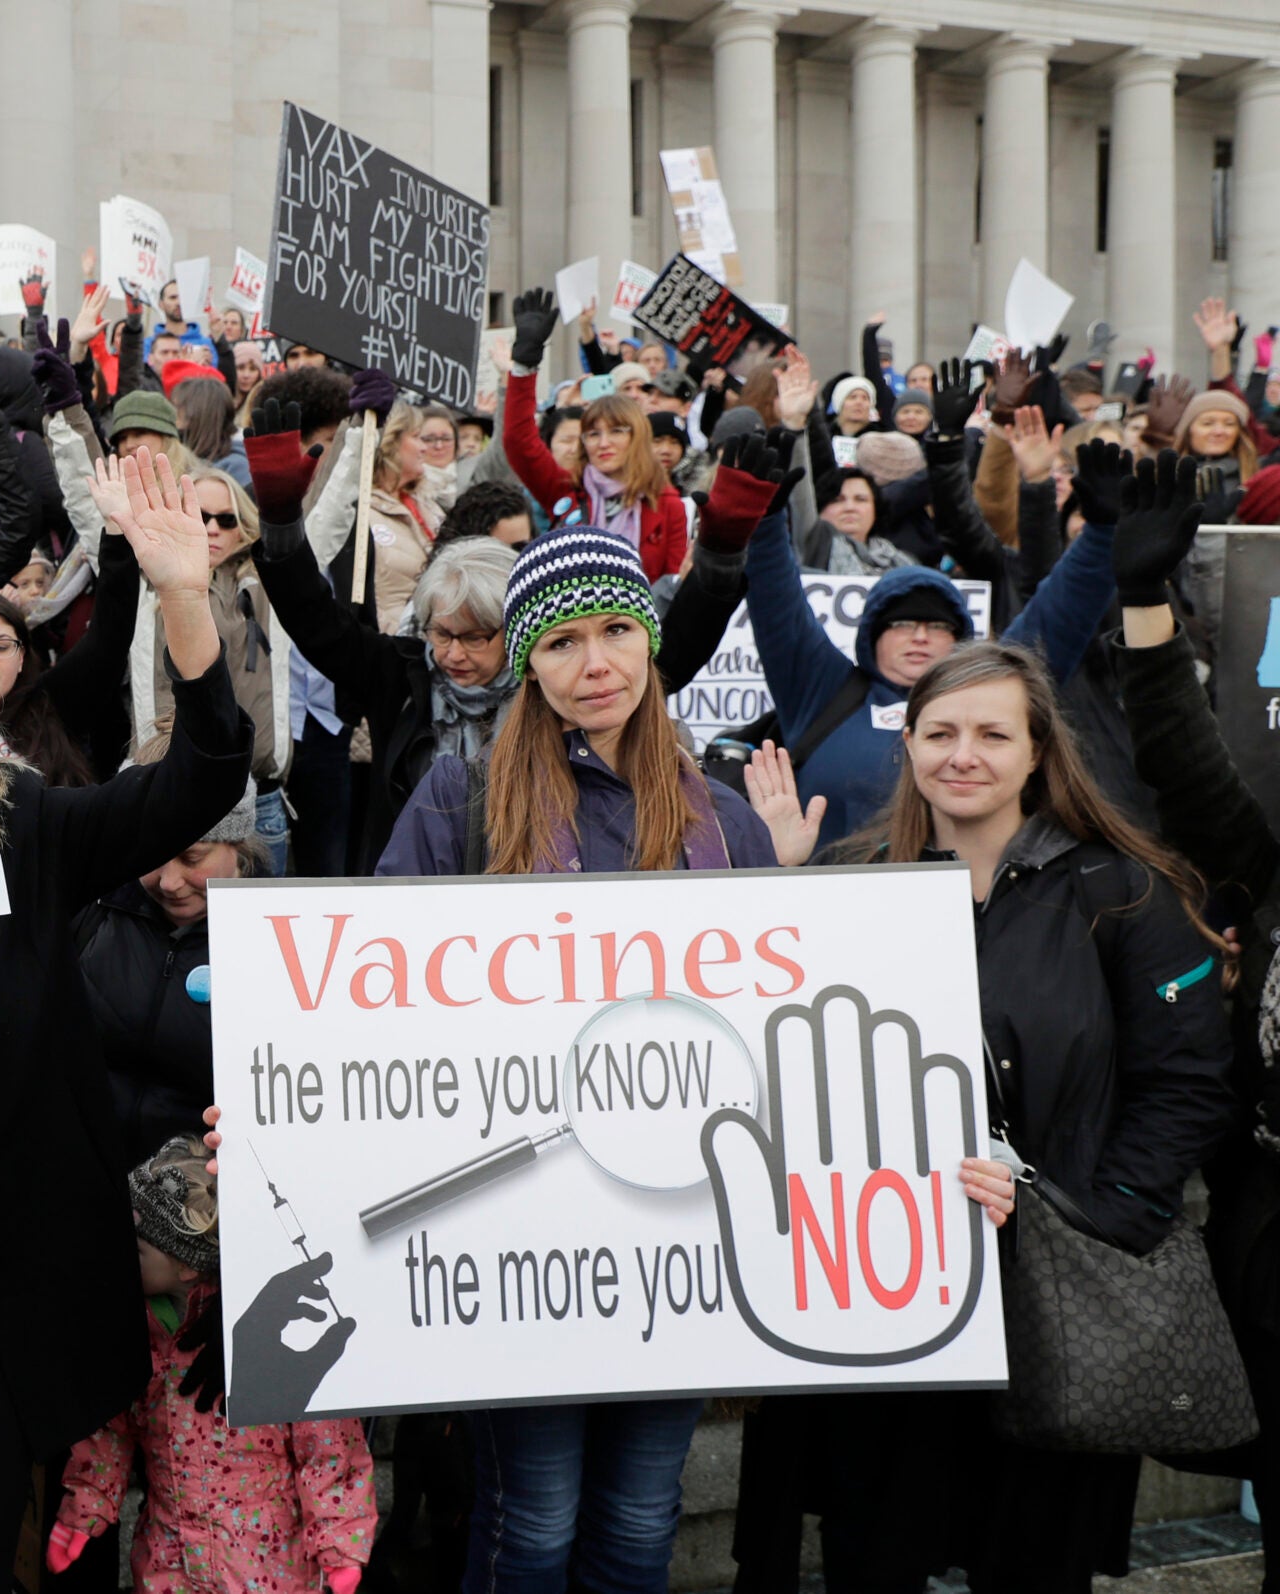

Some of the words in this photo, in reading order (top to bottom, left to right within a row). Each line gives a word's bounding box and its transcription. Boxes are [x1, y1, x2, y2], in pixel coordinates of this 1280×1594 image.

[286, 147, 359, 223] HURT
[370, 198, 413, 248] MY
[425, 222, 484, 283] KIDS
[295, 106, 377, 189] VAX
[389, 167, 490, 249] INJURIES
[275, 240, 327, 301] FOR
[339, 264, 418, 343] YOURS!!
[278, 195, 302, 244] I
[309, 212, 350, 267] AM
[369, 236, 485, 322] FIGHTING
[361, 325, 472, 408] #WEDID
[263, 911, 806, 1012] Vaccines
[250, 1042, 324, 1127] the
[341, 1054, 460, 1122] more
[474, 1054, 560, 1139] you
[405, 1230, 480, 1328] the
[498, 1246, 620, 1323] more
[635, 1242, 723, 1343] you
[788, 1167, 950, 1312] NO!
